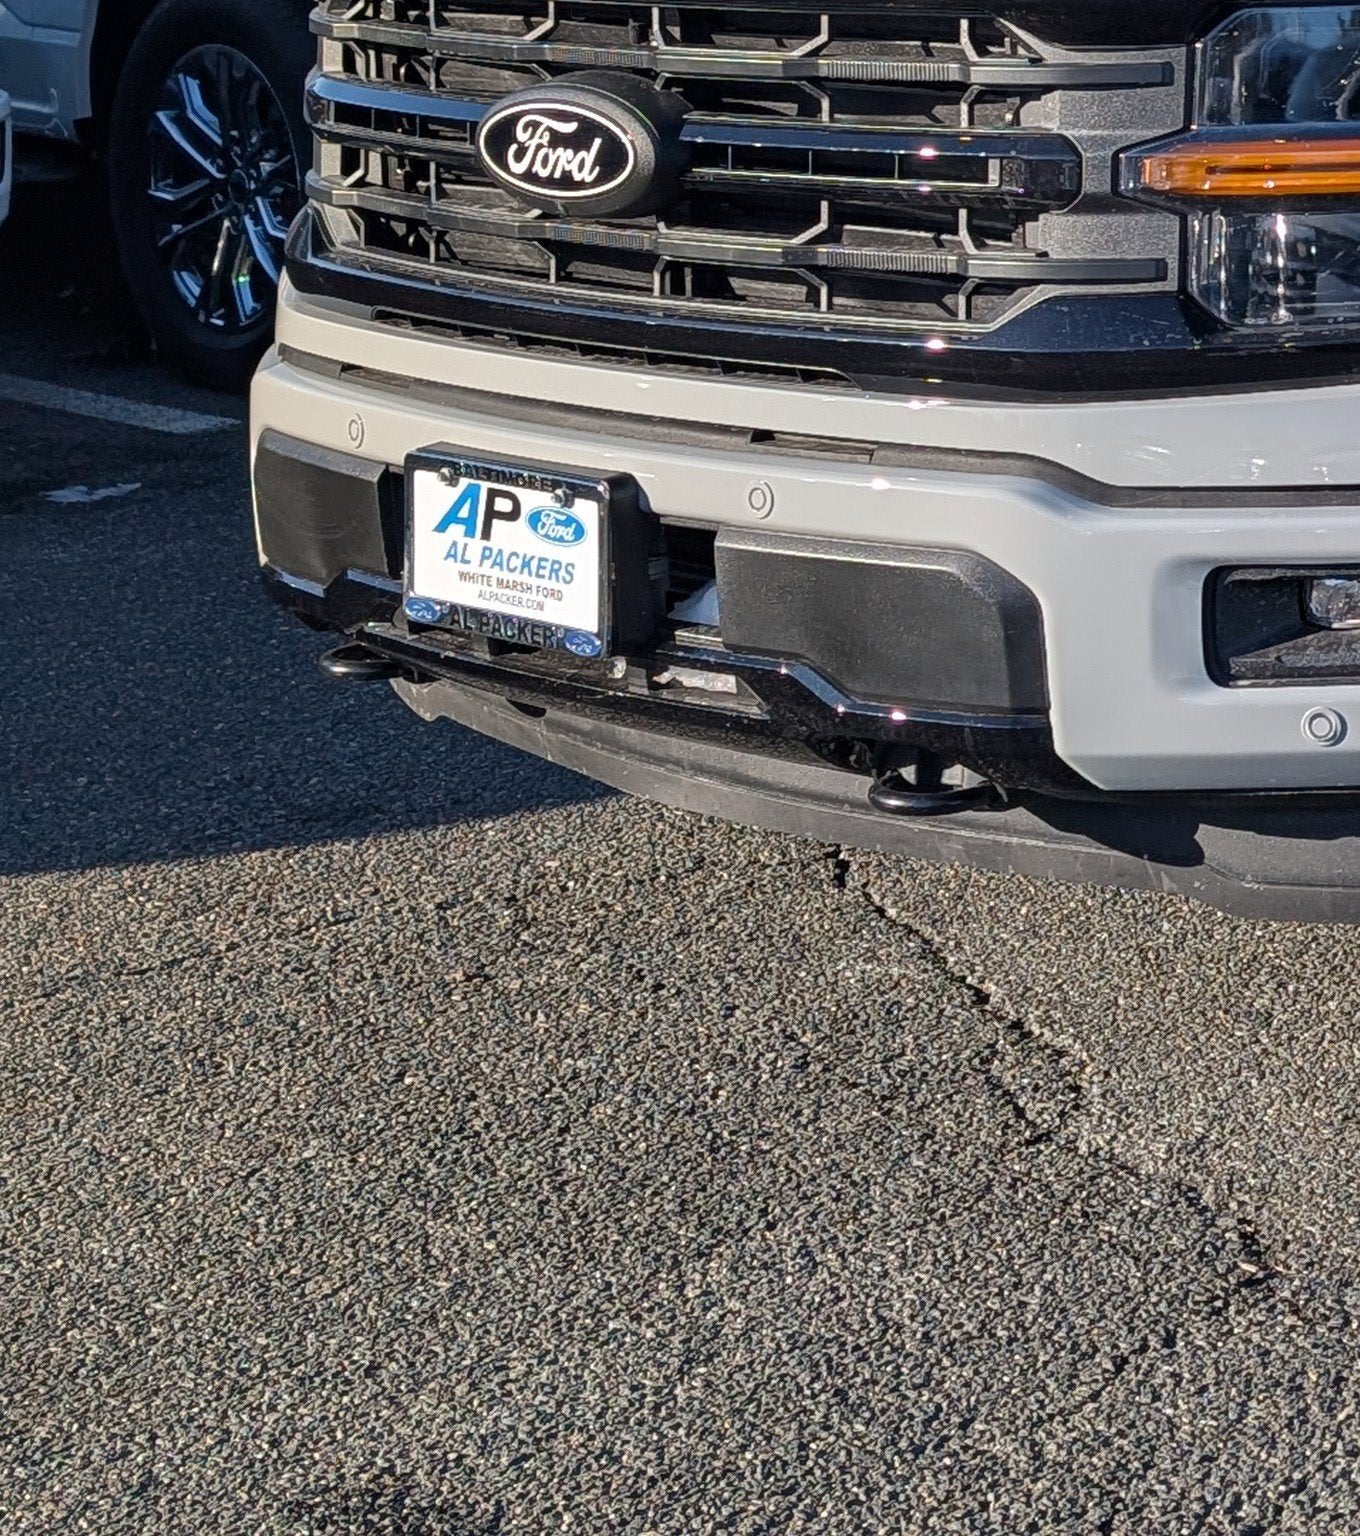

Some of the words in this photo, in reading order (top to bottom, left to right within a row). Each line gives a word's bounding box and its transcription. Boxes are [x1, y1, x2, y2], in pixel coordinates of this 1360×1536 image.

[506, 114, 602, 183] Ford
[432, 482, 522, 542] AP
[537, 509, 577, 541] Ford
[443, 540, 472, 565] AL
[478, 546, 576, 585] PACKERS
[457, 570, 493, 588] WHITE
[495, 576, 533, 595] MARSH
[535, 585, 564, 602] FORD
